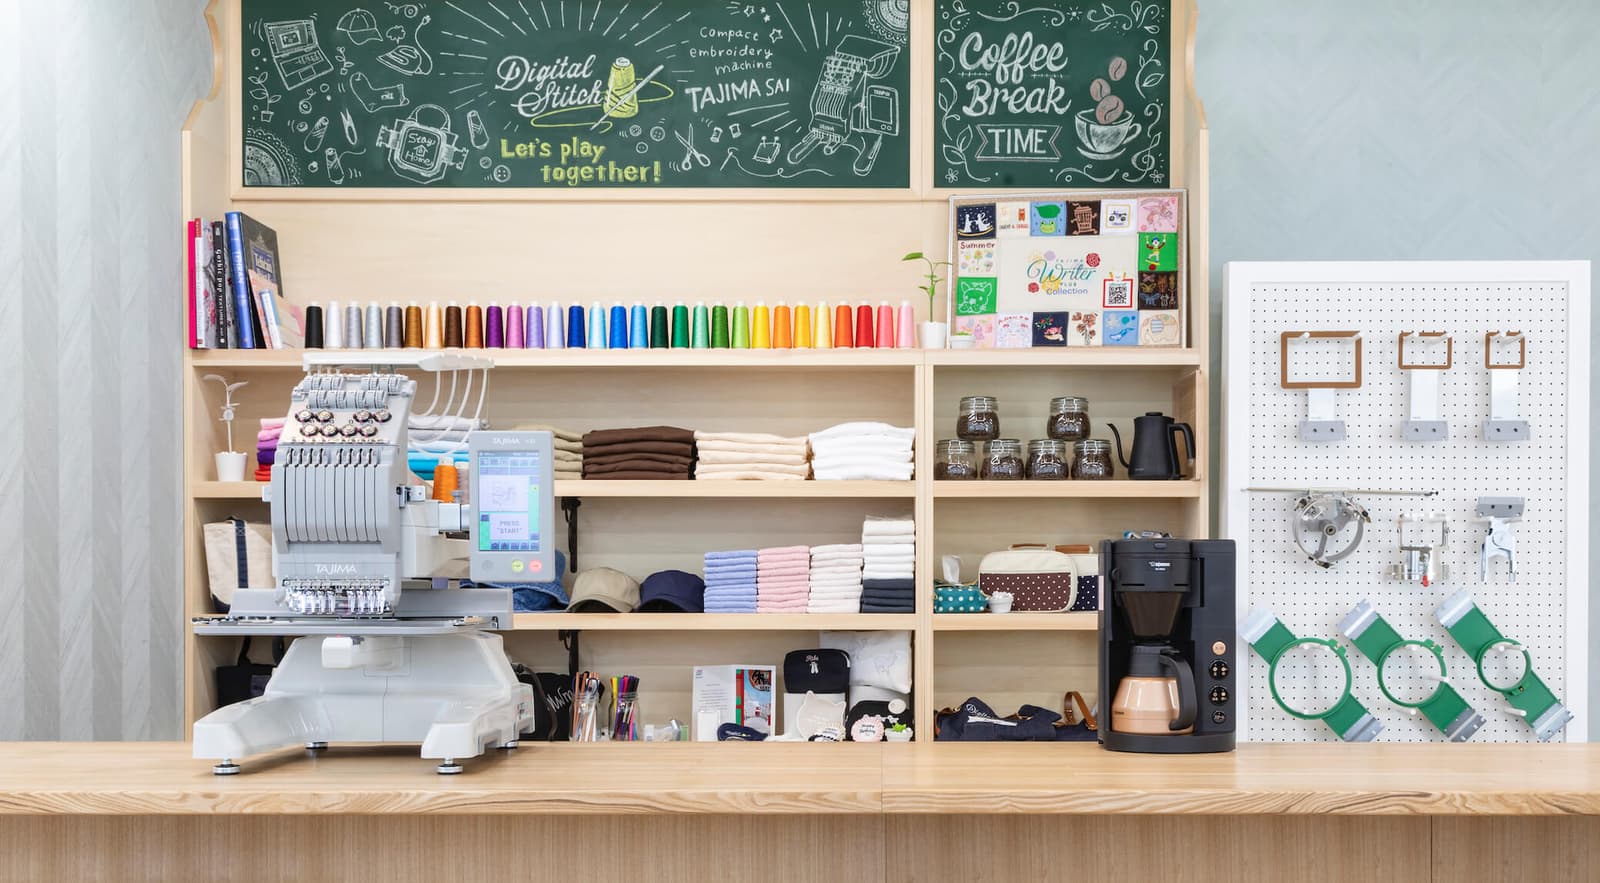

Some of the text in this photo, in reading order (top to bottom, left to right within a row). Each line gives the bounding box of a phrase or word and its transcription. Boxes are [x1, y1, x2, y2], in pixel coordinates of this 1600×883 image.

[700, 27, 759, 41] Compact
[689, 46, 774, 60] embroidery
[959, 31, 1069, 84] Coffee
[495, 54, 597, 93] Digital
[714, 60, 773, 76] machine
[510, 79, 604, 118] Stitch
[685, 78, 791, 113] TAJIMA SAI
[962, 78, 1072, 117] Break
[408, 132, 436, 147] Stay
[500, 136, 607, 163] Let's play
[988, 128, 1048, 154] TIME
[540, 160, 662, 186] together!
[960, 241, 995, 249] Summer
[1026, 259, 1097, 284] Writer
[1046, 287, 1088, 296] Collection
[314, 563, 358, 575] TAJIMA
